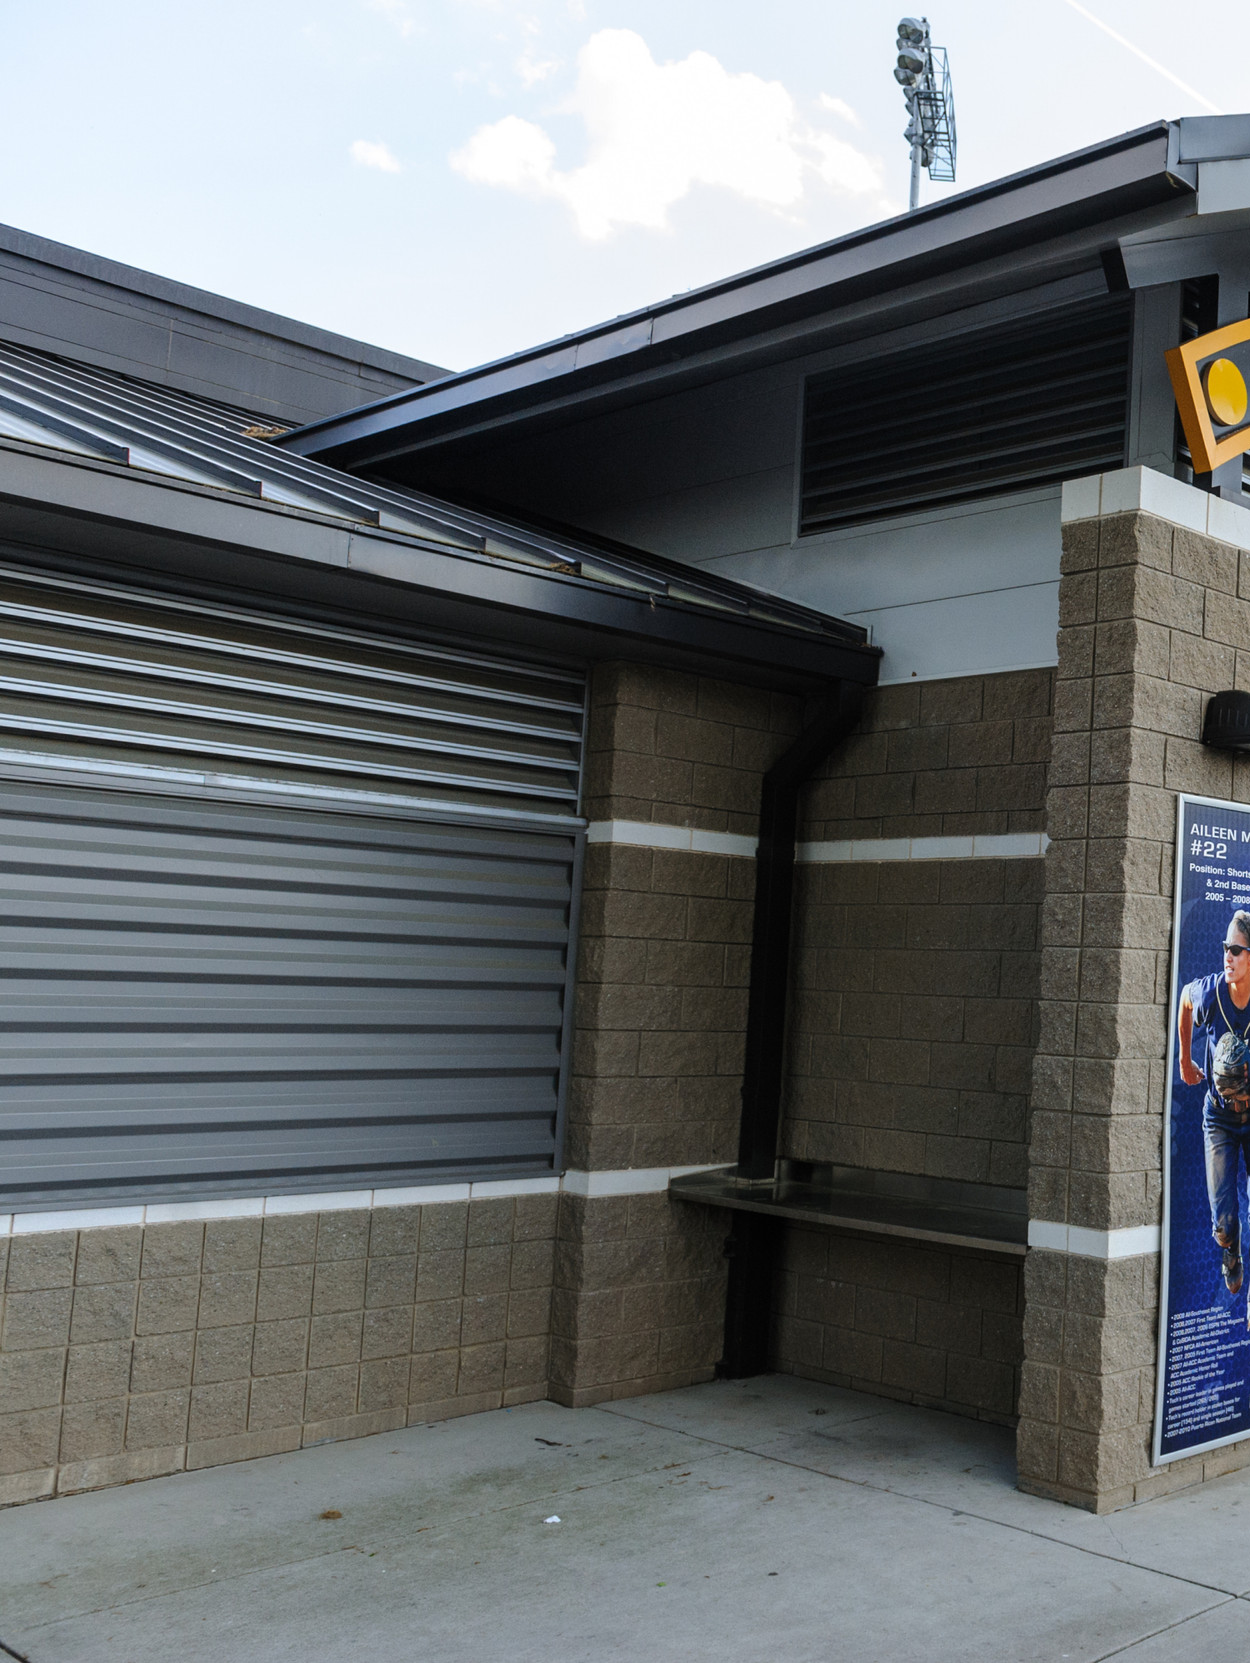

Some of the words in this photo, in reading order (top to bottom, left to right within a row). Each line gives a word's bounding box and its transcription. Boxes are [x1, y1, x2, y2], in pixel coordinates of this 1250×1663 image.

[1190, 823, 1237, 841] AILEEN
[1190, 839, 1227, 859] #22
[1189, 863, 1225, 875] Position:
[1206, 878, 1213, 887] &
[1214, 879, 1230, 889] 2nd
[1231, 881, 1250, 891] Base
[1205, 892, 1224, 902] 2005
[1232, 895, 1250, 904] 2008
